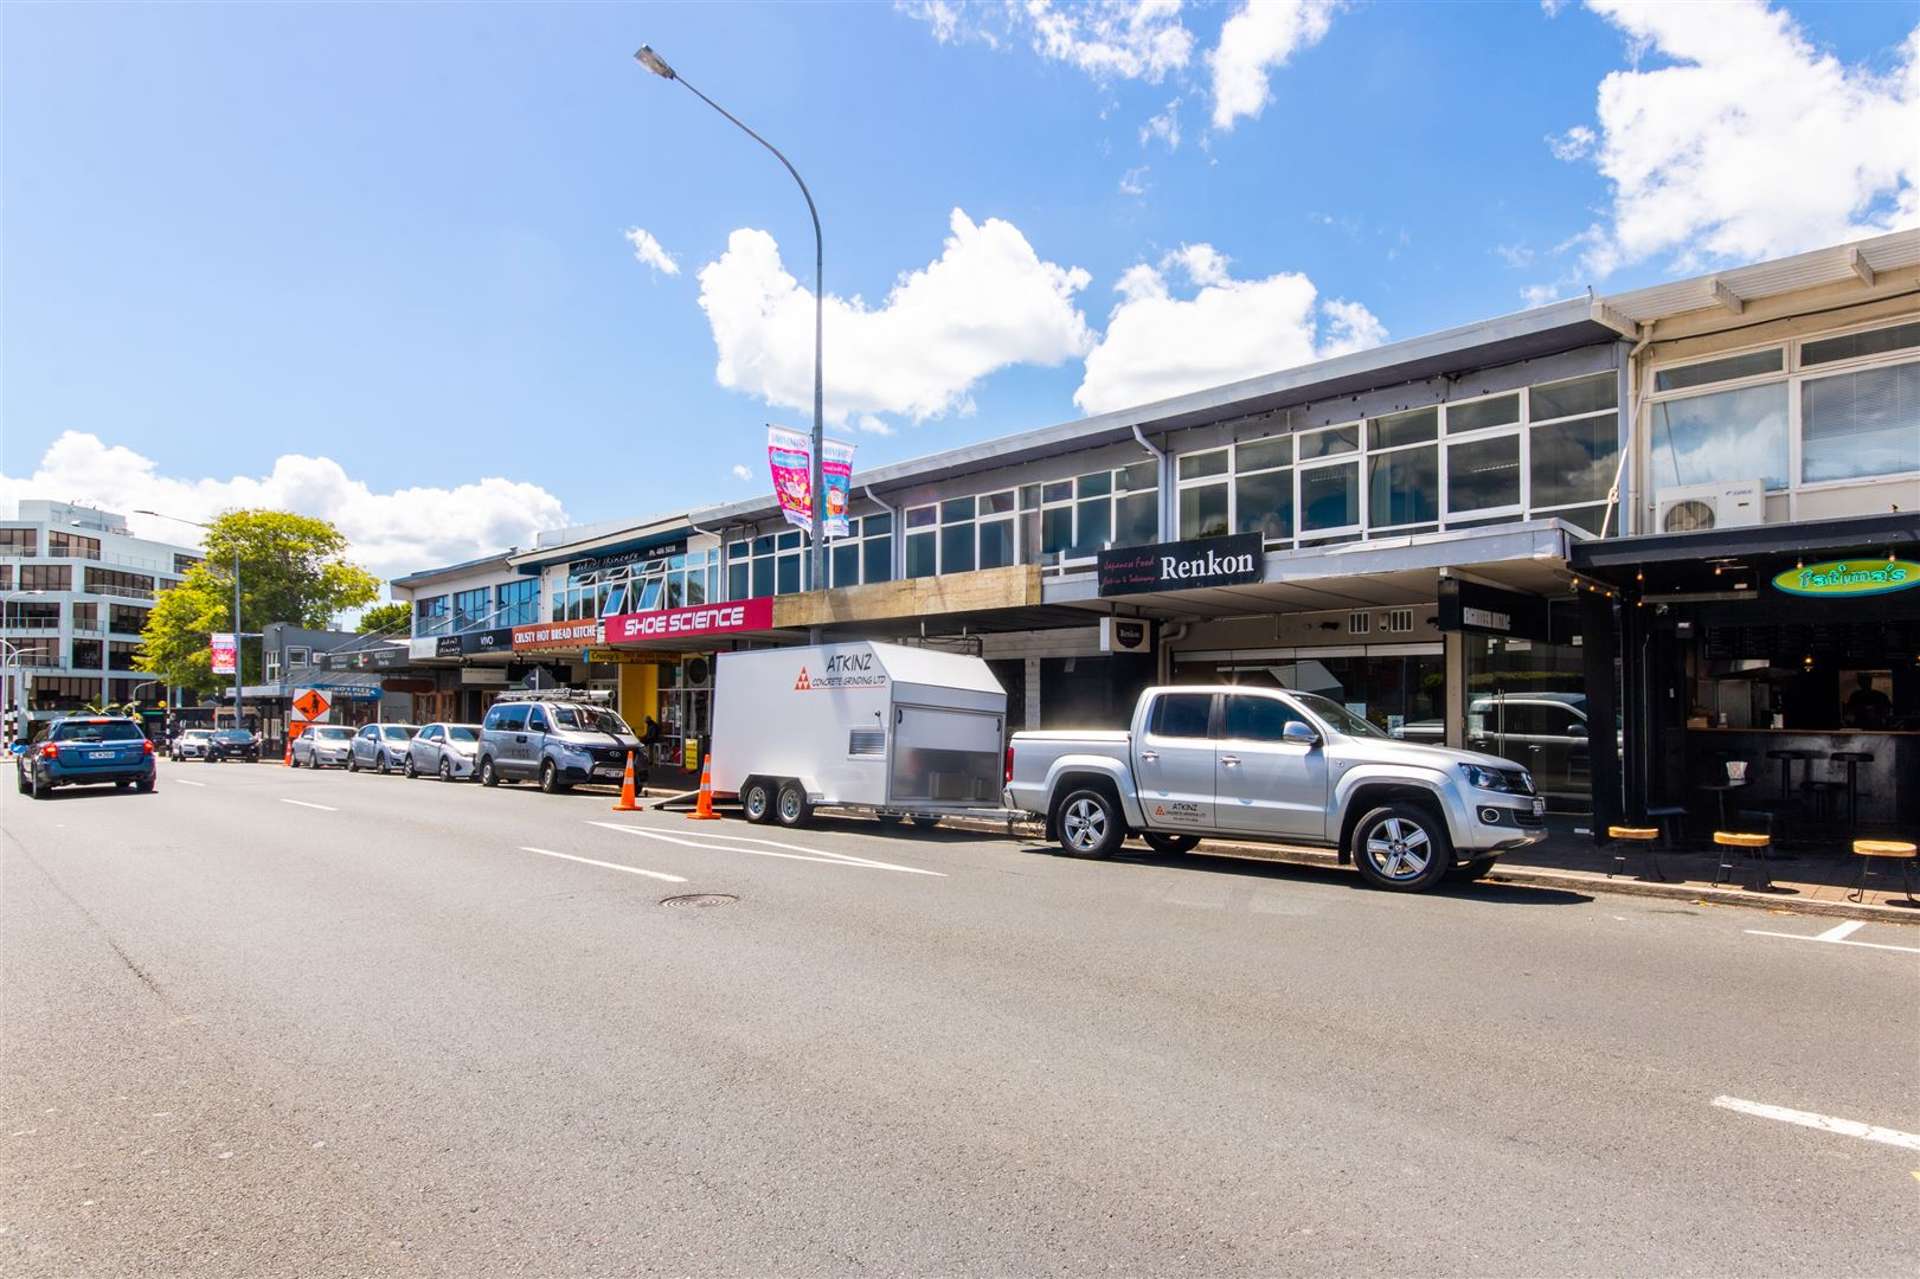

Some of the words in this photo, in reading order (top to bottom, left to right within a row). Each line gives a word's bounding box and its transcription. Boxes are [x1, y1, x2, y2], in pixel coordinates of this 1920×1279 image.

[1135, 555, 1154, 567] Food
[1160, 550, 1255, 580] Renkon
[624, 616, 667, 636] SHOE
[669, 607, 745, 632] SCIENCE
[480, 635, 494, 645] VIVO
[514, 631, 535, 644] CRUSTY
[537, 630, 551, 642] HOT
[551, 628, 572, 641] BREAD
[826, 653, 872, 673] ATKINZ
[812, 677, 842, 687] CONCRETE
[843, 675, 872, 686] GRINDING
[873, 675, 886, 685] LTD
[1172, 803, 1198, 812] ATKINZ
